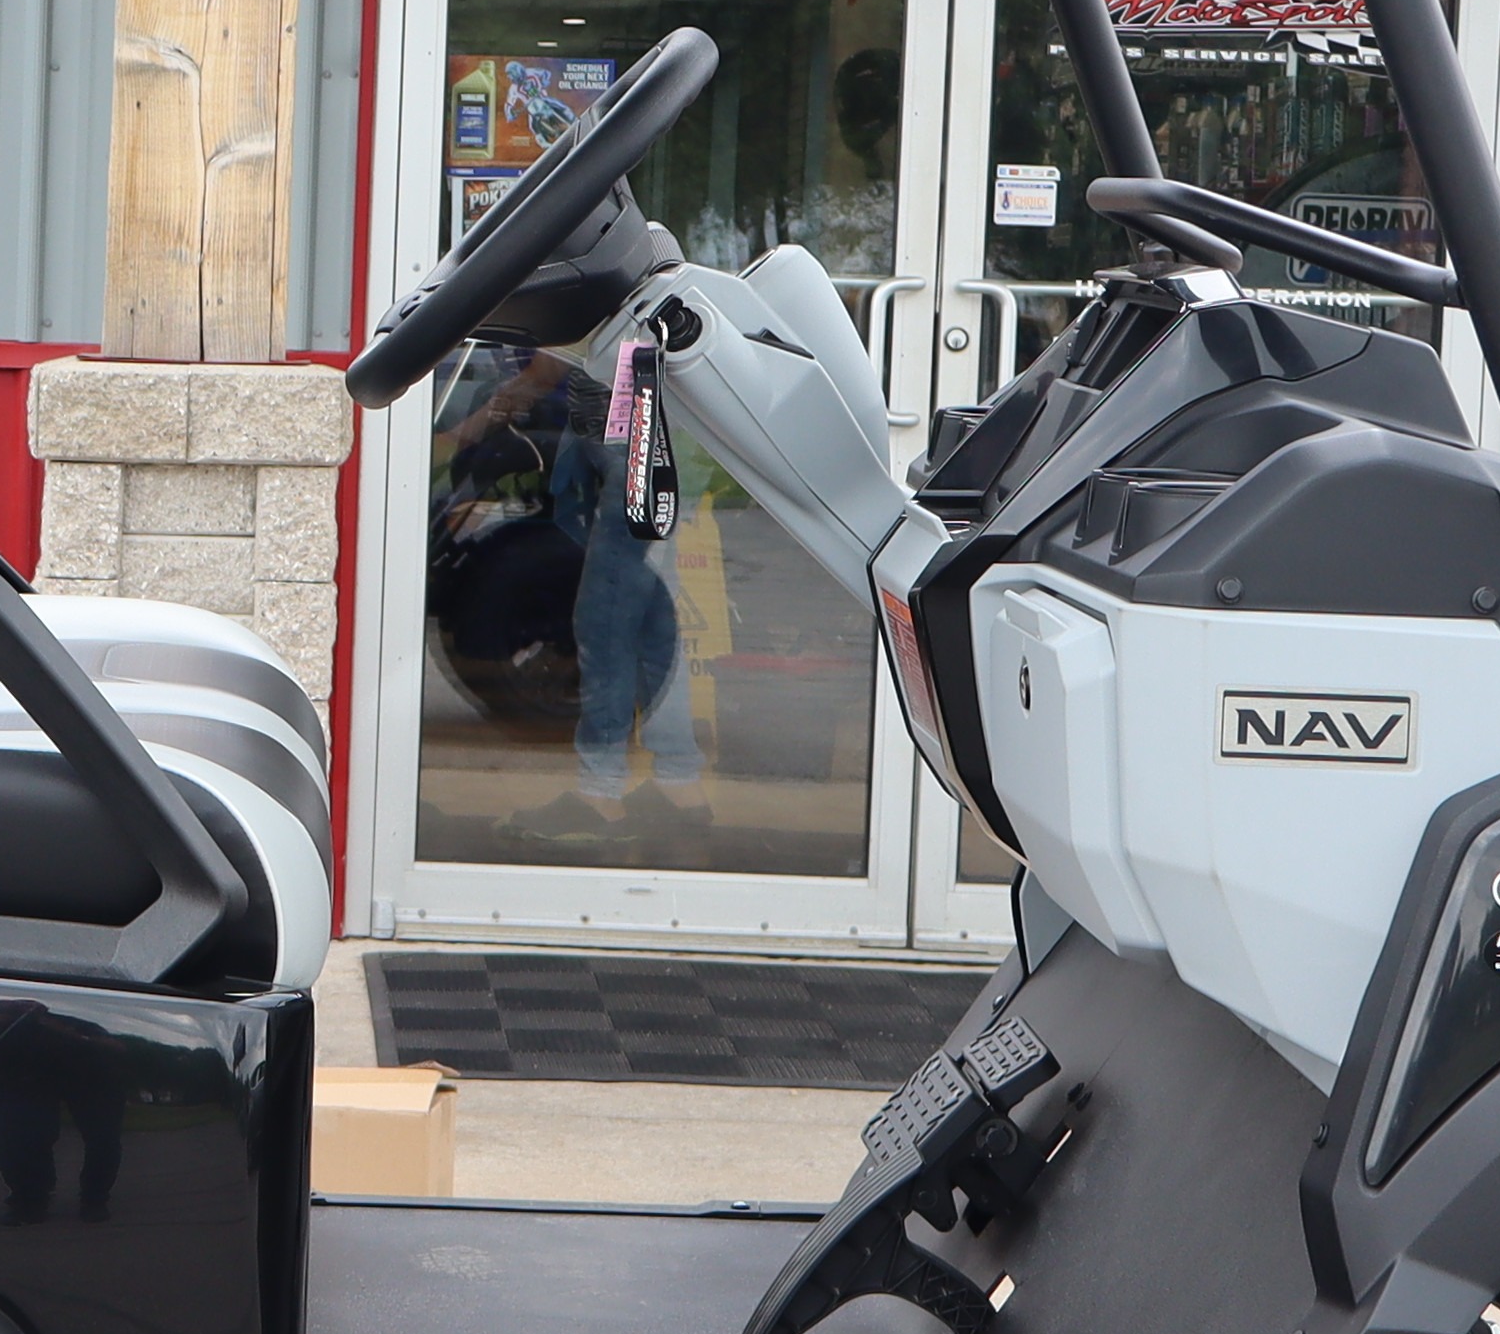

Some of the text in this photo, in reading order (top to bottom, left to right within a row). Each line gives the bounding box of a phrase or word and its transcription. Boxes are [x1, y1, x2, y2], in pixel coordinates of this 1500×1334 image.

[1162, 47, 1288, 63] SERVICE
[1307, 52, 1387, 66] SALE
[566, 63, 609, 72] SCHEDULE
[562, 72, 609, 81] YOUR NEXT
[558, 80, 609, 90] OIL CHANGE
[1243, 287, 1372, 309] PERATION
[1235, 708, 1404, 750] NAV
